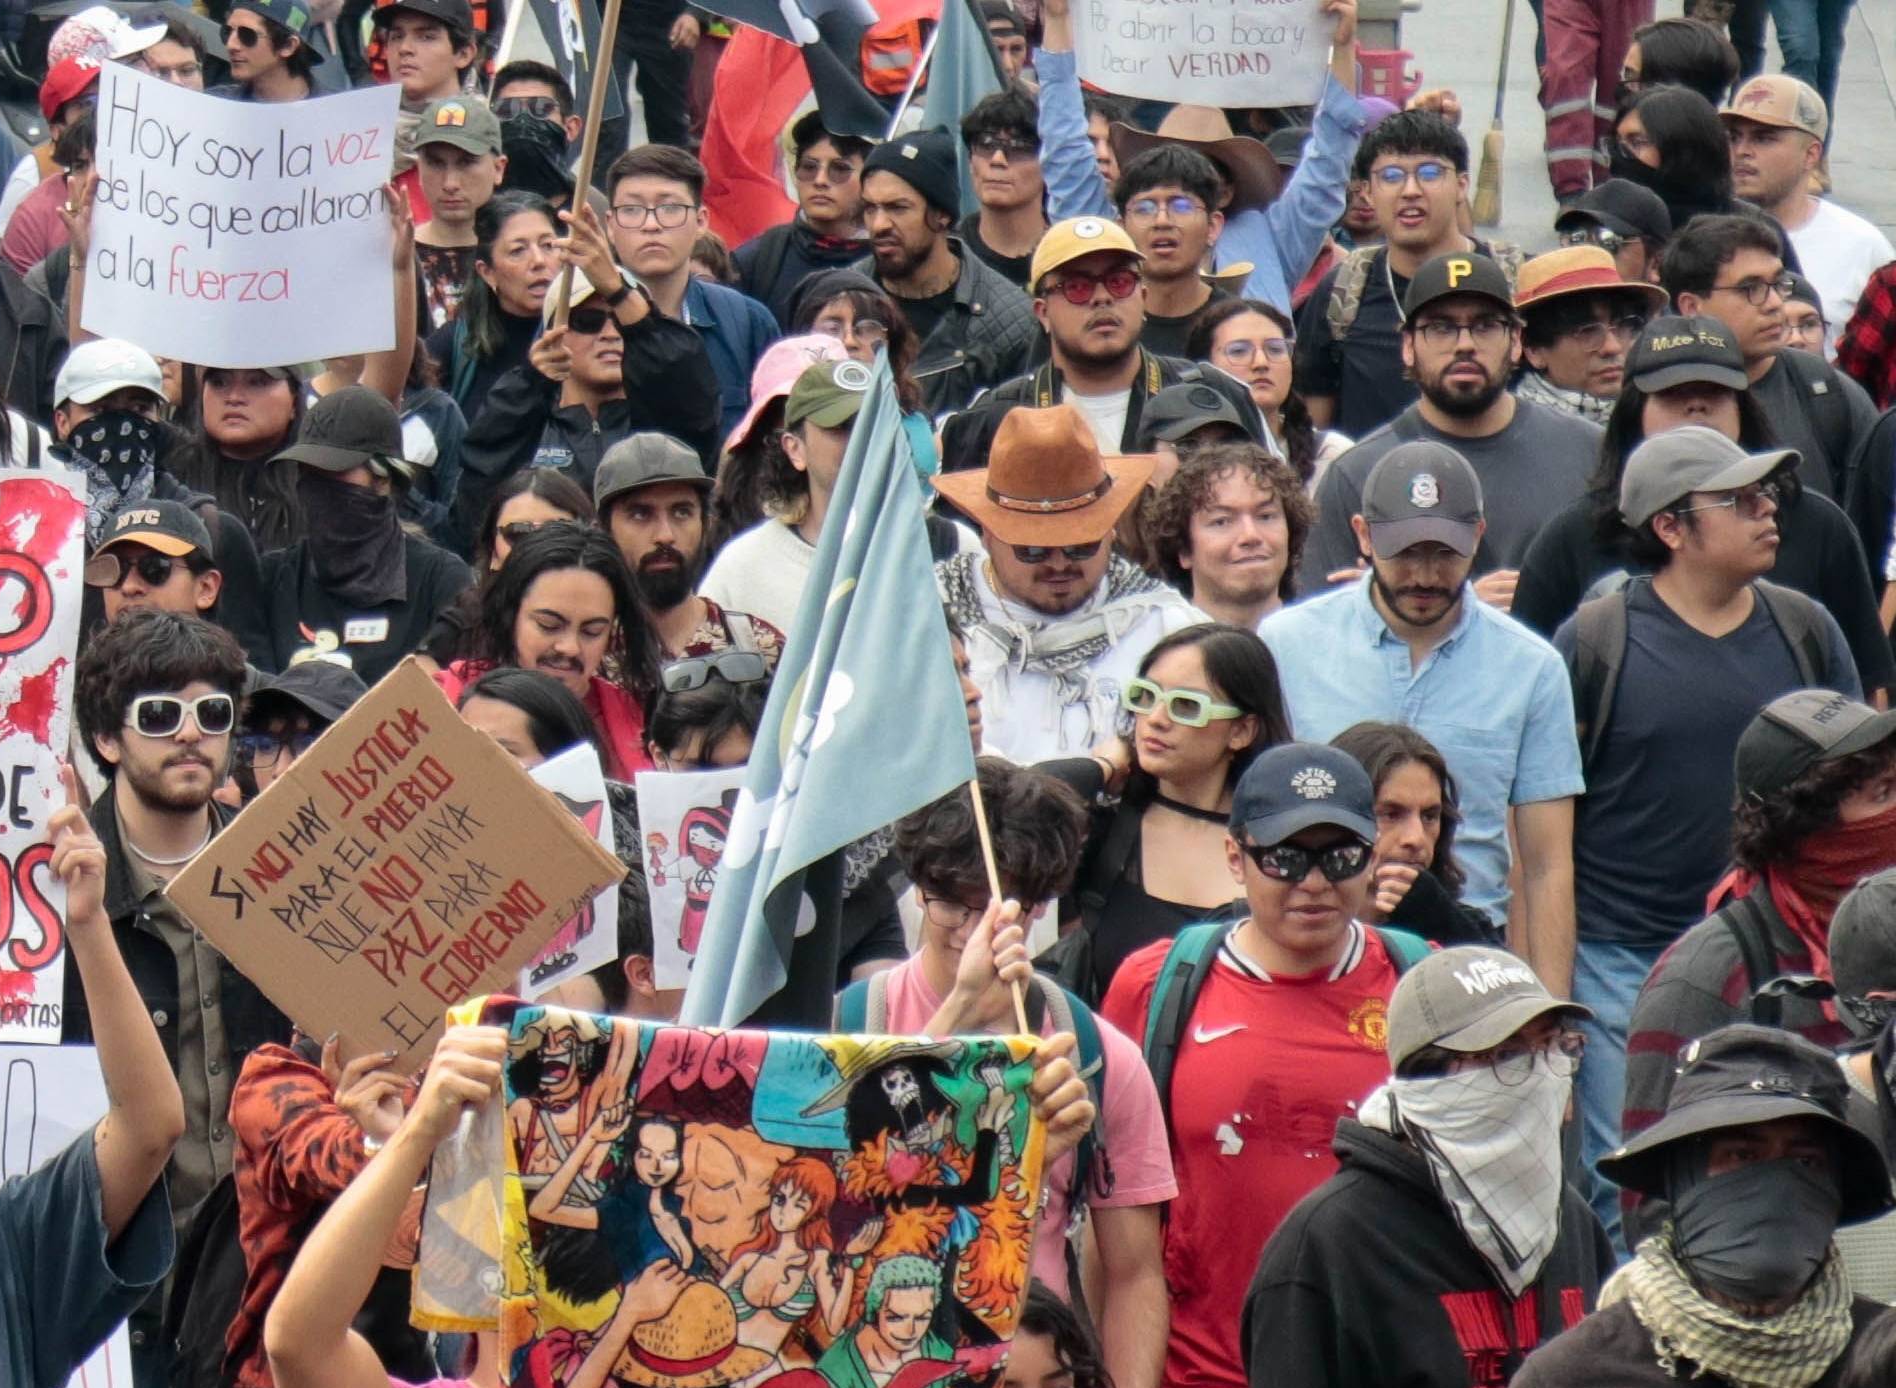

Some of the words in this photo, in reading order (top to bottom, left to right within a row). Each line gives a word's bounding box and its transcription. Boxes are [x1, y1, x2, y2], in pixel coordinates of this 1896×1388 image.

[1168, 52, 1271, 78] VERDAD
[1191, 13, 1214, 44] la
[279, 129, 312, 178] la
[97, 160, 129, 211] de
[139, 169, 179, 225] los
[188, 202, 254, 249] que
[261, 186, 385, 234] callaron
[97, 248, 118, 280] a
[128, 235, 155, 290] la
[169, 245, 290, 302] fuerza
[114, 509, 161, 532] NYC
[209, 865, 256, 920] SI
[243, 839, 294, 895] NO
[281, 796, 331, 857] HAY
[320, 707, 431, 818] JUSTICIA
[270, 862, 350, 934] PARA
[333, 836, 378, 873] EL
[362, 754, 456, 844] PUEBLO
[304, 893, 380, 965] QUE
[358, 852, 426, 915] NO
[407, 802, 485, 874] HAYA
[359, 905, 447, 989] PAZ
[425, 857, 504, 930] PARA
[381, 1000, 439, 1050] EL
[419, 877, 548, 1007] GOBIERNO
